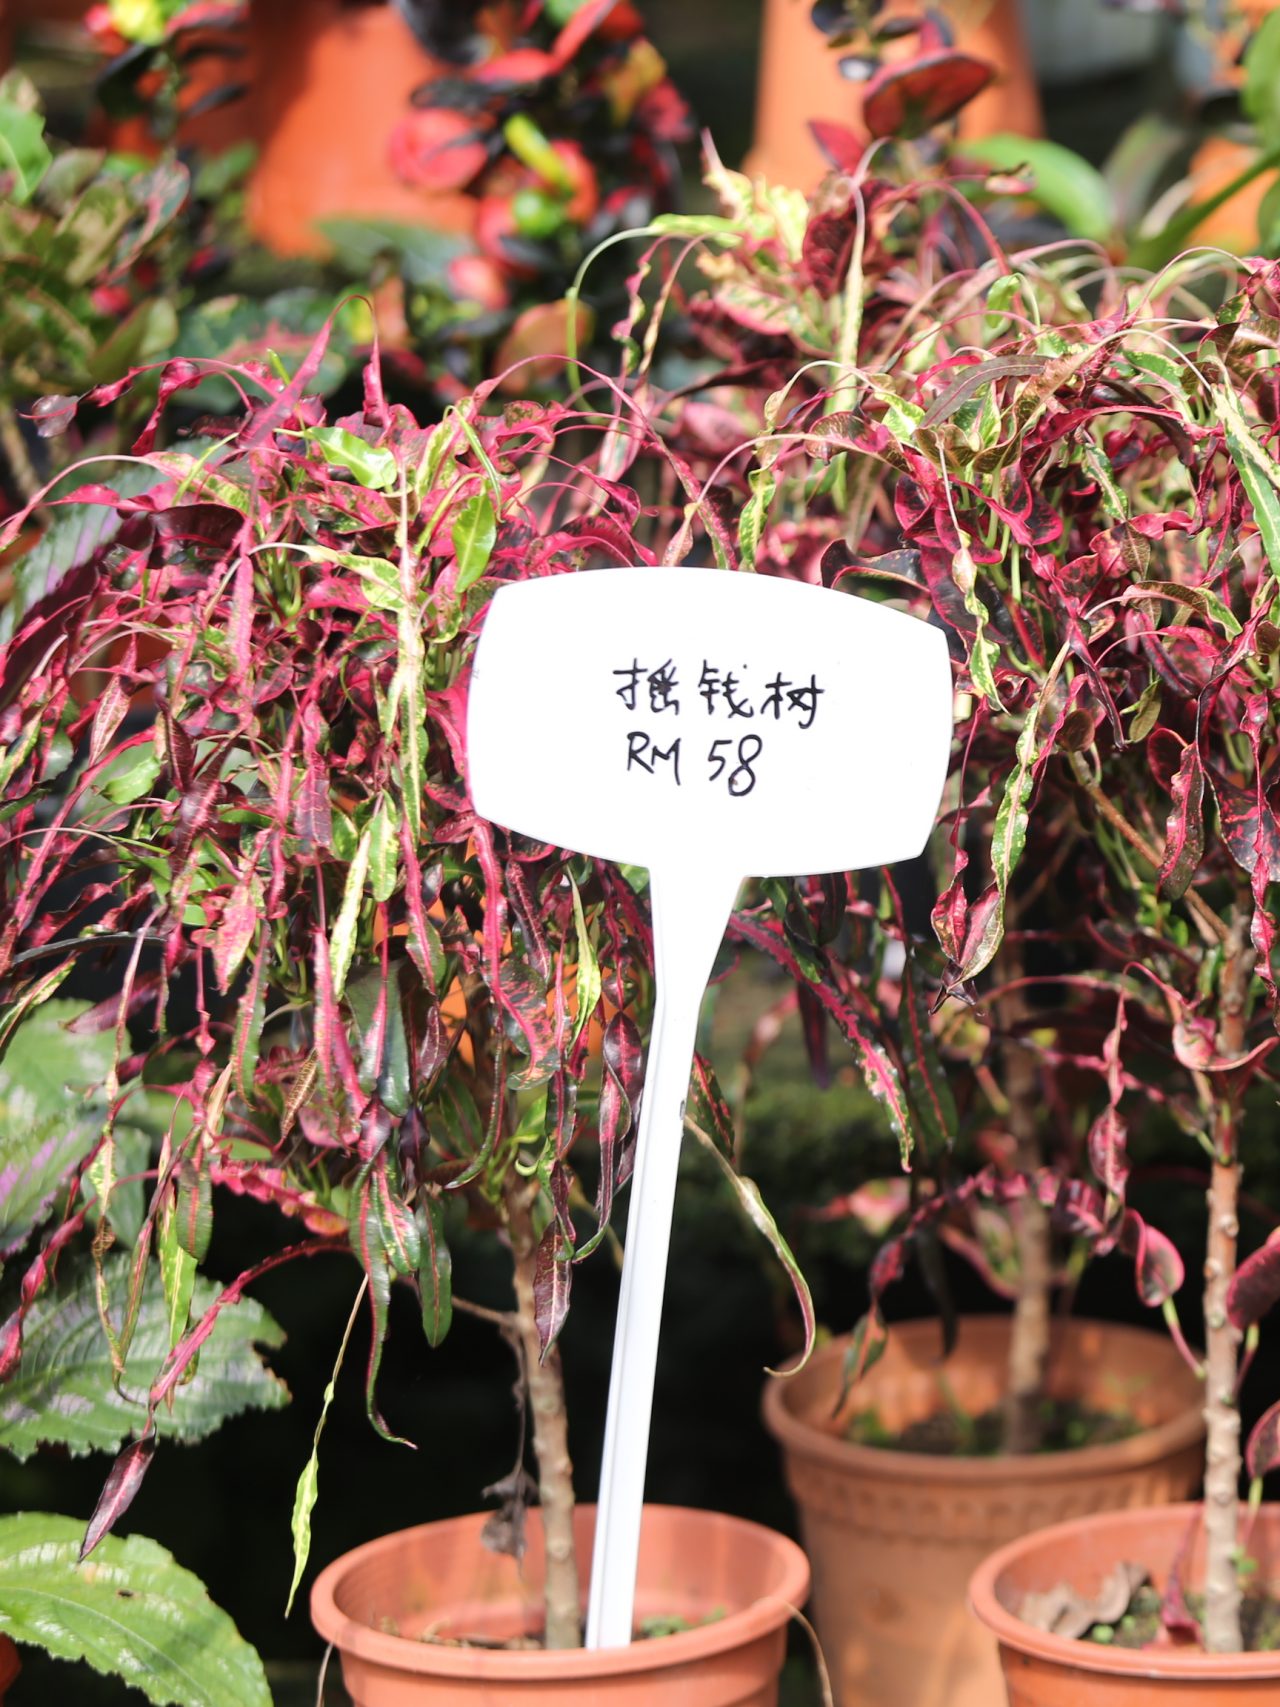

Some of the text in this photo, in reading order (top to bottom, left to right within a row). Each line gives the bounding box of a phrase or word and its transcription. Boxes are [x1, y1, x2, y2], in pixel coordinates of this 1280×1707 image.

[612, 657, 825, 730] 摇钱树
[626, 731, 763, 797] RM 58
